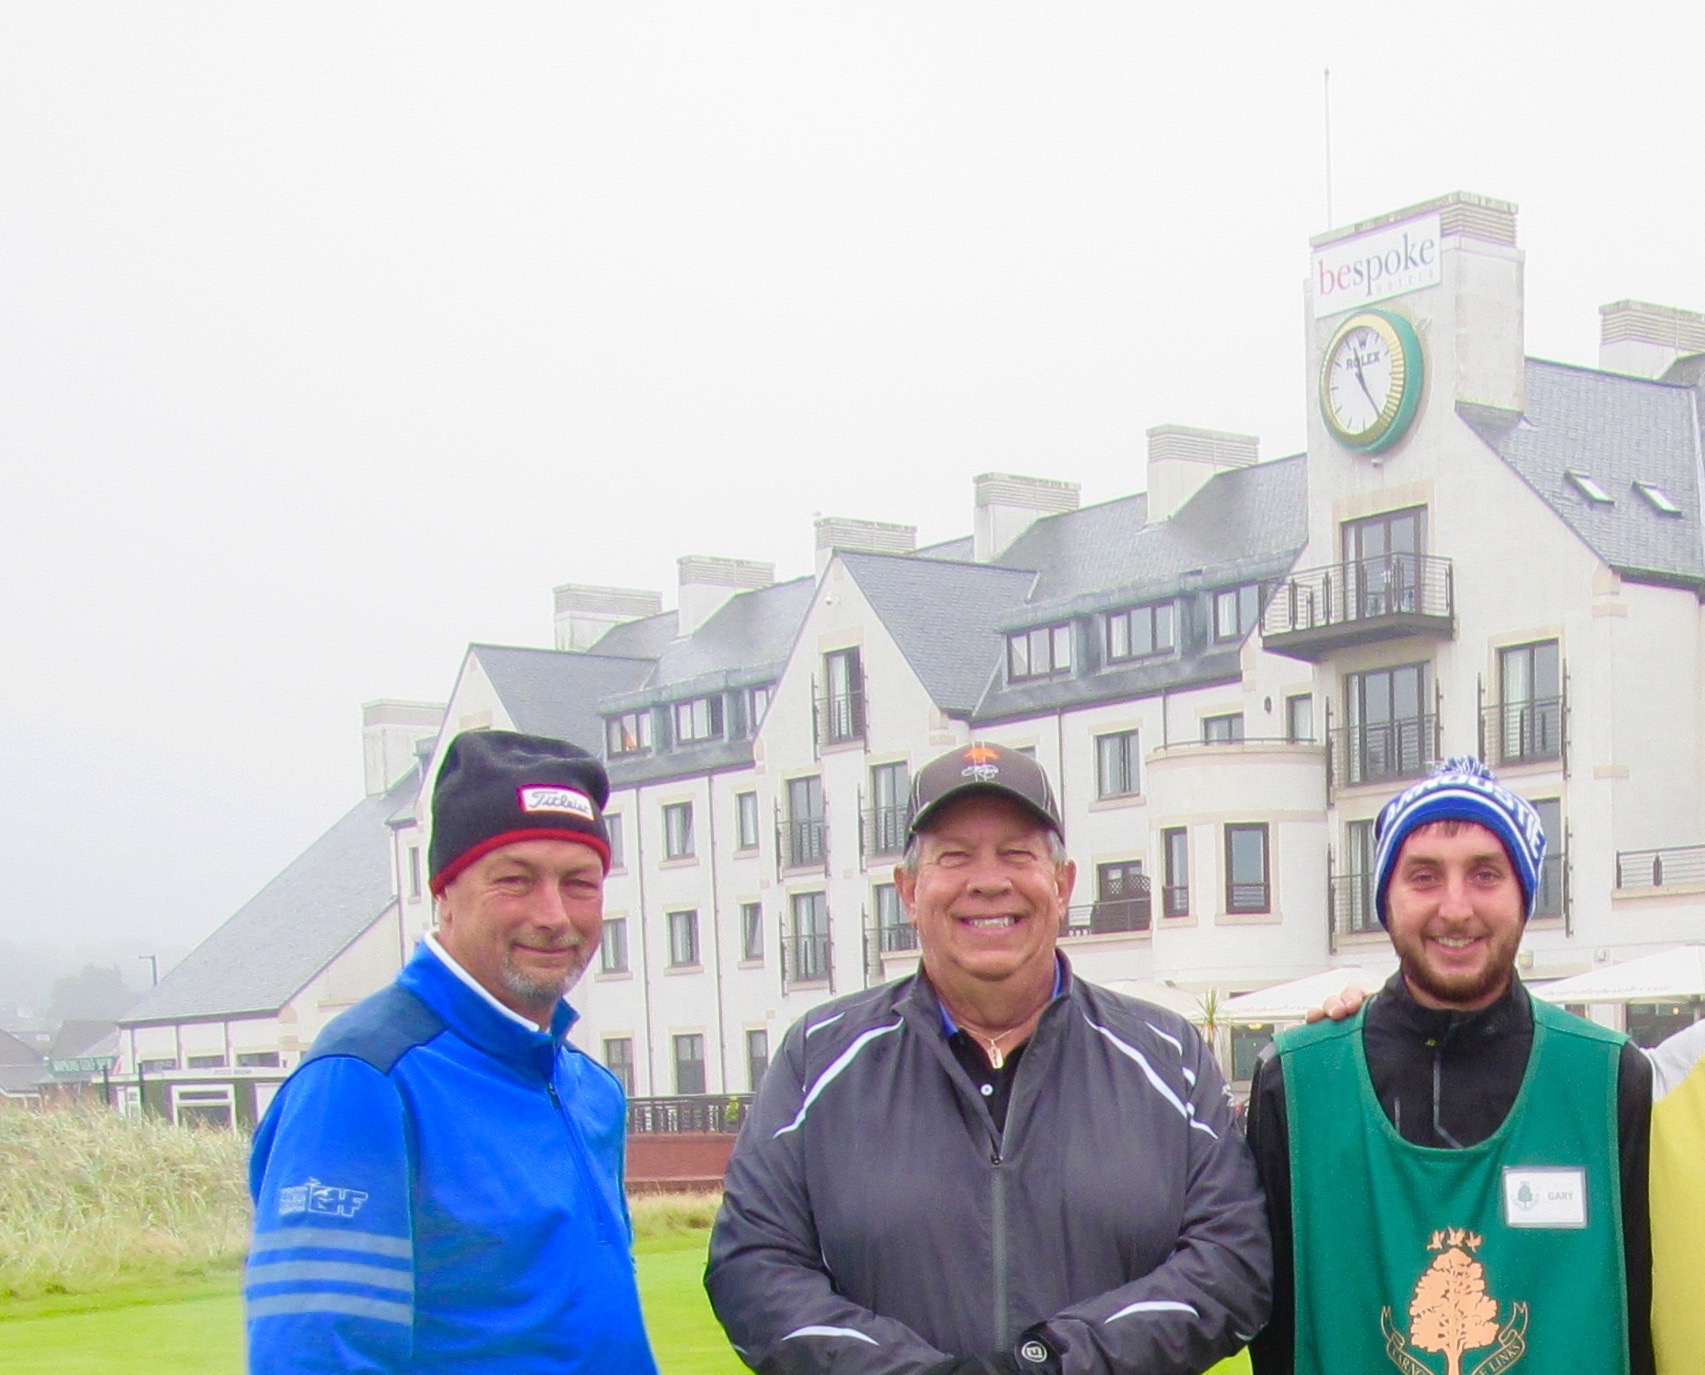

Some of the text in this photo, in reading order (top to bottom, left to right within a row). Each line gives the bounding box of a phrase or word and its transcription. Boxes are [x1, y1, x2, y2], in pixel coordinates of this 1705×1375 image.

[1318, 233, 1436, 297] bespoke
[1346, 350, 1381, 370] ROLEX
[1547, 1190, 1574, 1202] GARY
[1487, 1343, 1521, 1373] LINKS
